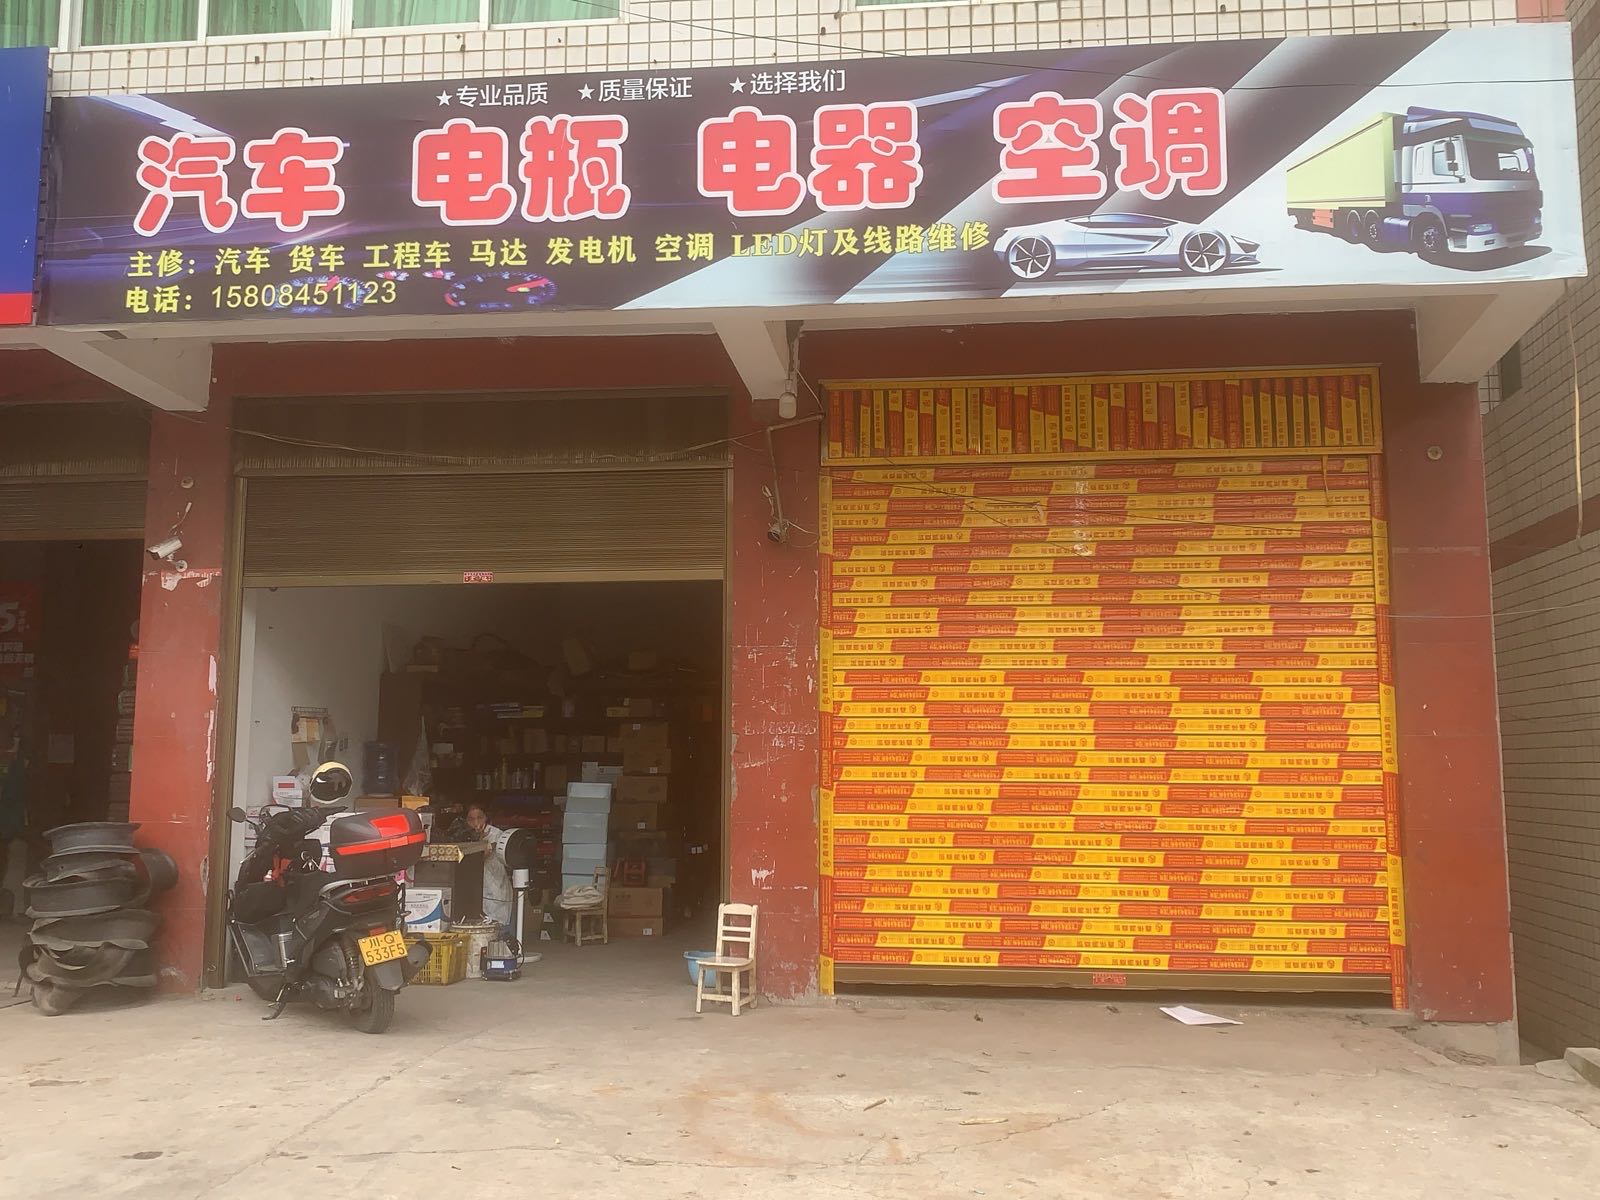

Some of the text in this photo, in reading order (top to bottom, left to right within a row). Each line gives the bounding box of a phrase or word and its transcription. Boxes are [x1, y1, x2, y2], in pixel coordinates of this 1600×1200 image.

[456, 69, 846, 107] 专业品质 质量保证 选择我们
[133, 87, 1228, 236] 汽车 电瓶 电器 空调
[215, 245, 271, 276] 汽车
[289, 243, 345, 273] 货车
[363, 240, 451, 270] 工程车
[469, 238, 528, 268] 马达
[547, 235, 636, 265] 发电机
[655, 232, 715, 262] 空调
[731, 221, 990, 260] LED灯及线路维修
[212, 280, 397, 309] 15808451123
[365, 943, 405, 963] 533F5
